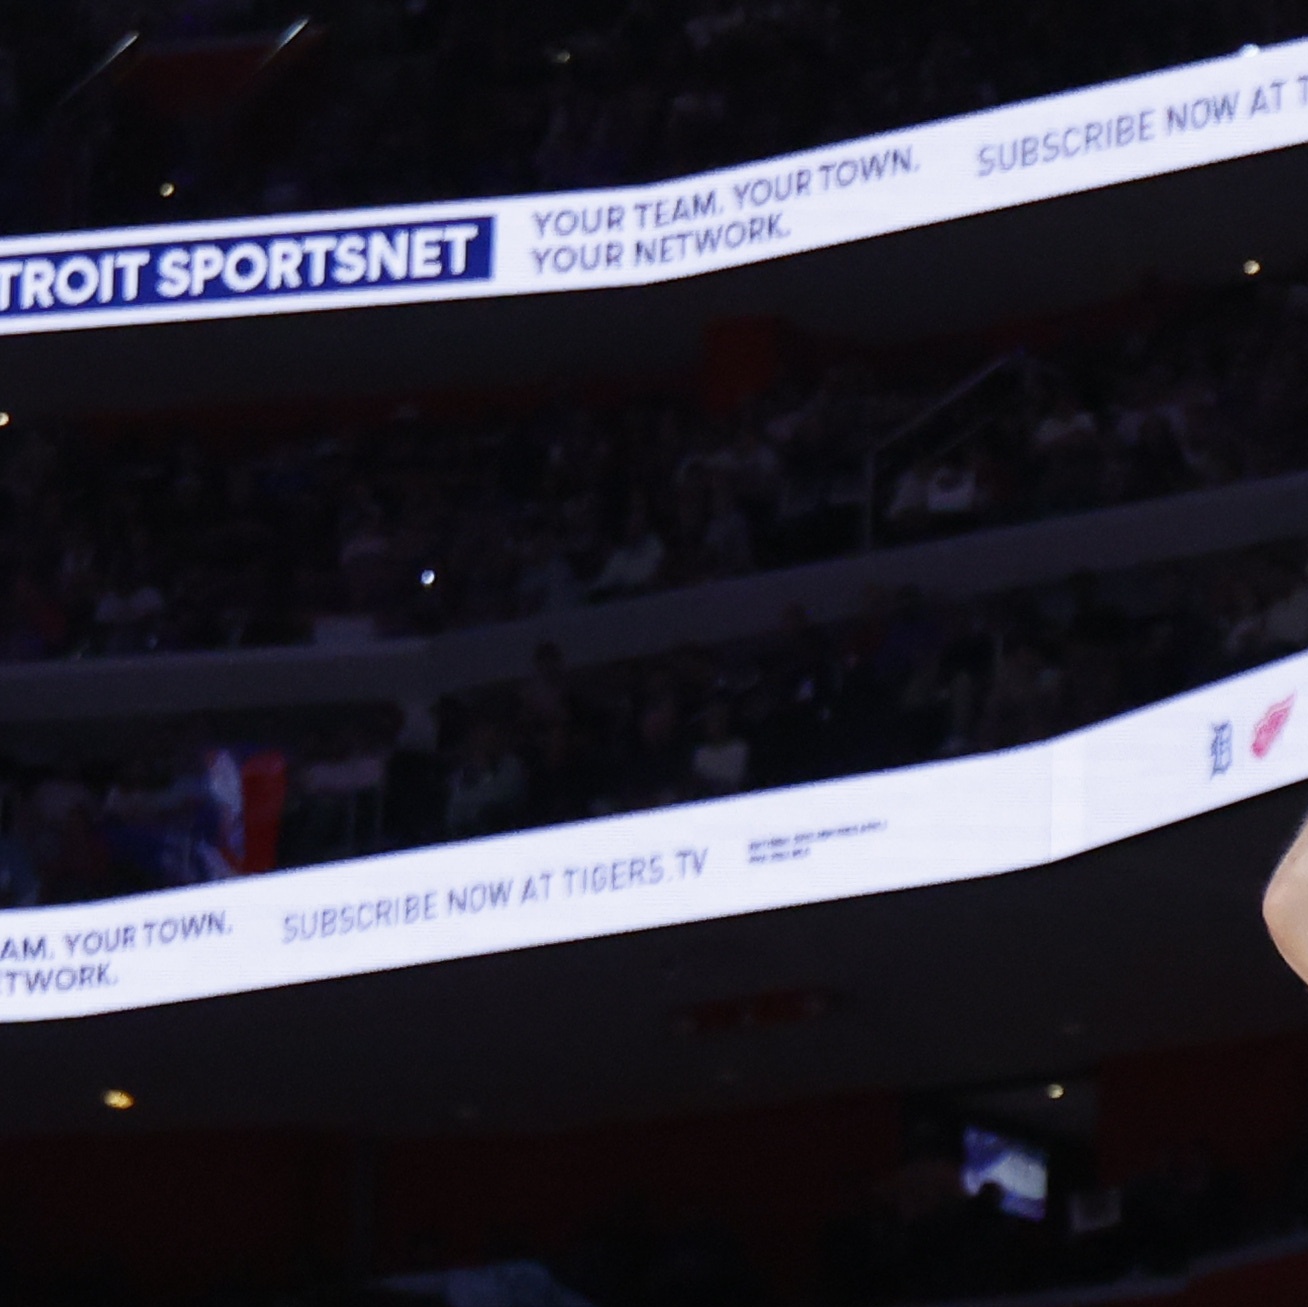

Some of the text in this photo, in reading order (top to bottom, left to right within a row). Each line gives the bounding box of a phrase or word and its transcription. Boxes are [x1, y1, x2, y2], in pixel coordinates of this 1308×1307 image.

[975, 109, 1157, 178] SUBSCRIBE
[1164, 90, 1241, 137] NOW
[1248, 80, 1288, 119] AT
[533, 145, 920, 239] YOUR TEAM. YOUR TOWN.
[155, 224, 481, 298] SPORTSNET
[531, 213, 793, 275] YOUR NETWORK.
[62, 925, 136, 957] YOUR
[143, 909, 234, 946] TOWN.
[281, 846, 710, 945] SUBSCRIBE NOW AT TIGERS.TV
